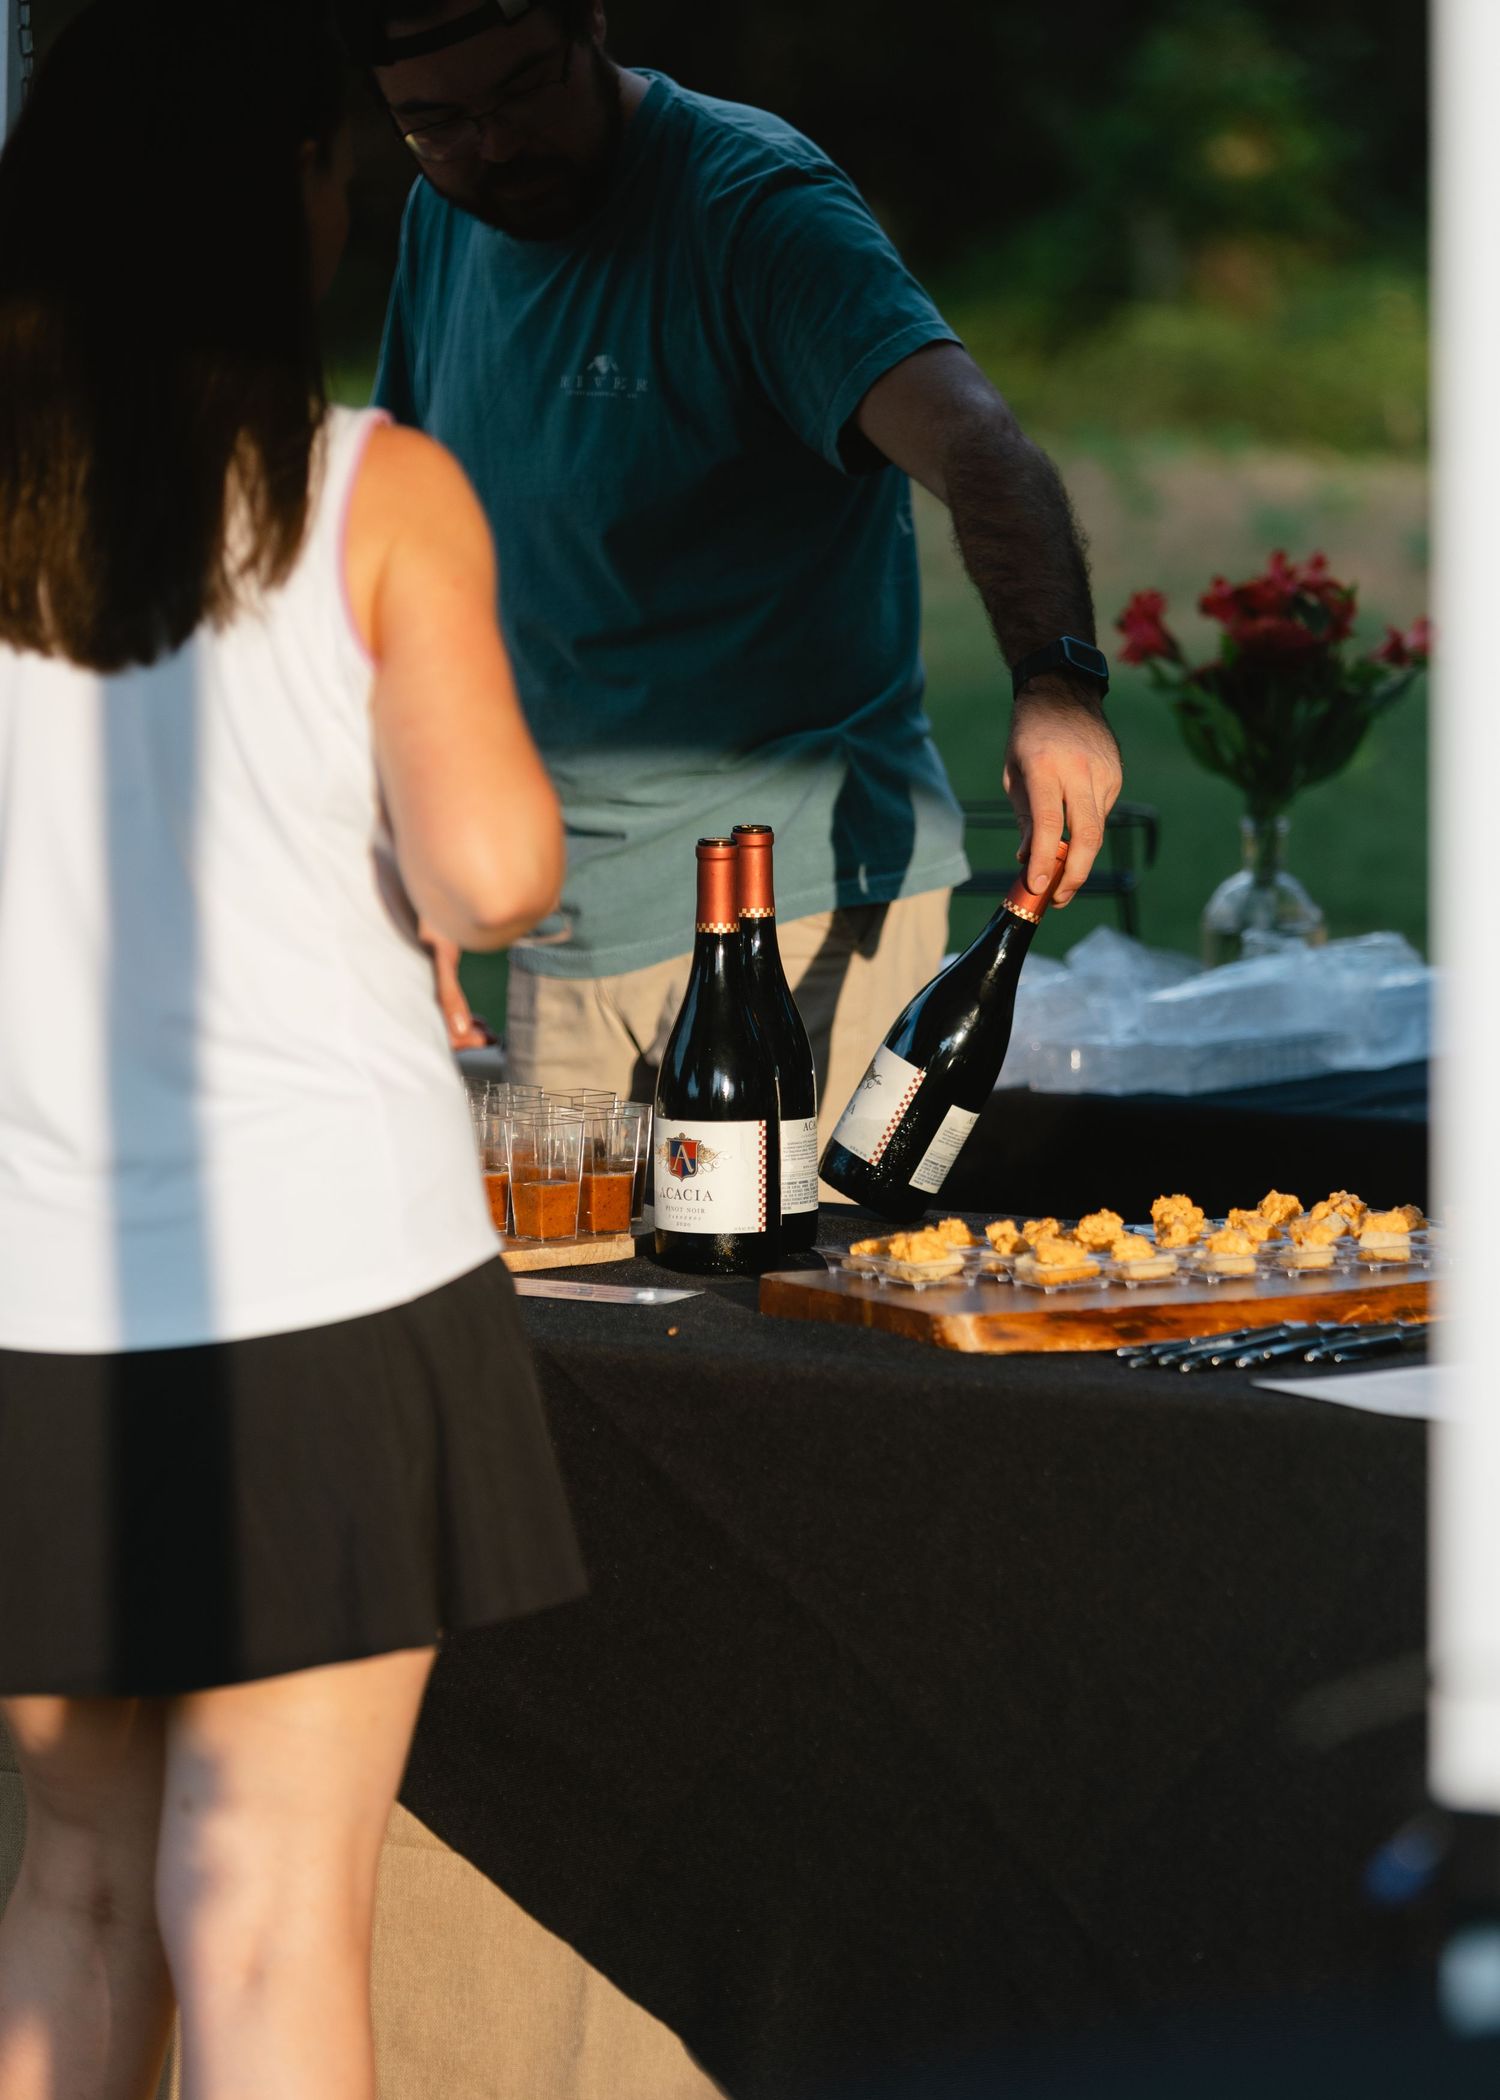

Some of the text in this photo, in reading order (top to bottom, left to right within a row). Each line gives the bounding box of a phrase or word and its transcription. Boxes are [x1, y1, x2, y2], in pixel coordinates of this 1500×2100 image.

[671, 1144, 695, 1174] A
[660, 1186, 713, 1202] ACACIA
[665, 1205, 683, 1213] PINOT
